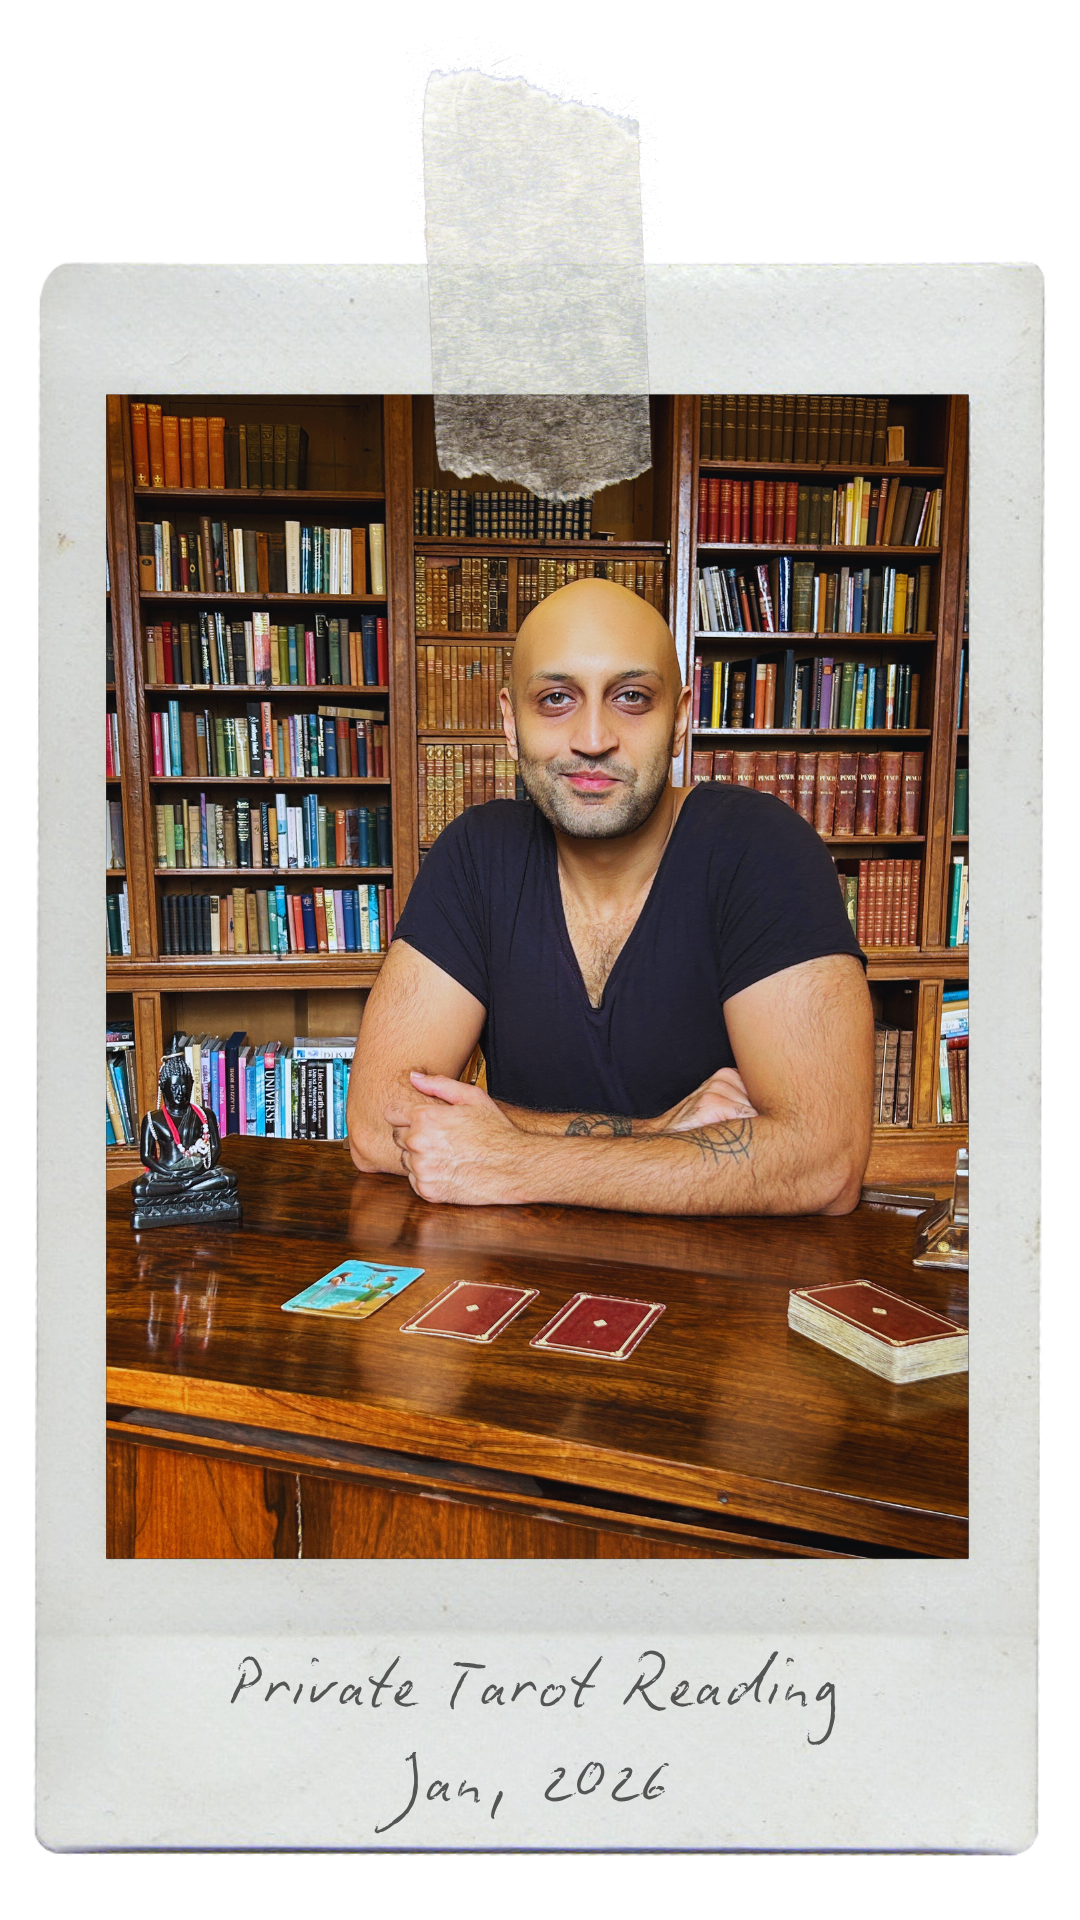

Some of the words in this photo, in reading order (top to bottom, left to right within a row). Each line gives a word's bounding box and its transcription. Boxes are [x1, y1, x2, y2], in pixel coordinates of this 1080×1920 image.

[265, 1070, 275, 1124] UNIVERSE
[230, 1655, 419, 1708] Private
[449, 1655, 603, 1710] Tarot
[622, 1650, 837, 1746] Reading
[374, 1751, 504, 1834] Jan,
[544, 1761, 669, 1802] 2026
